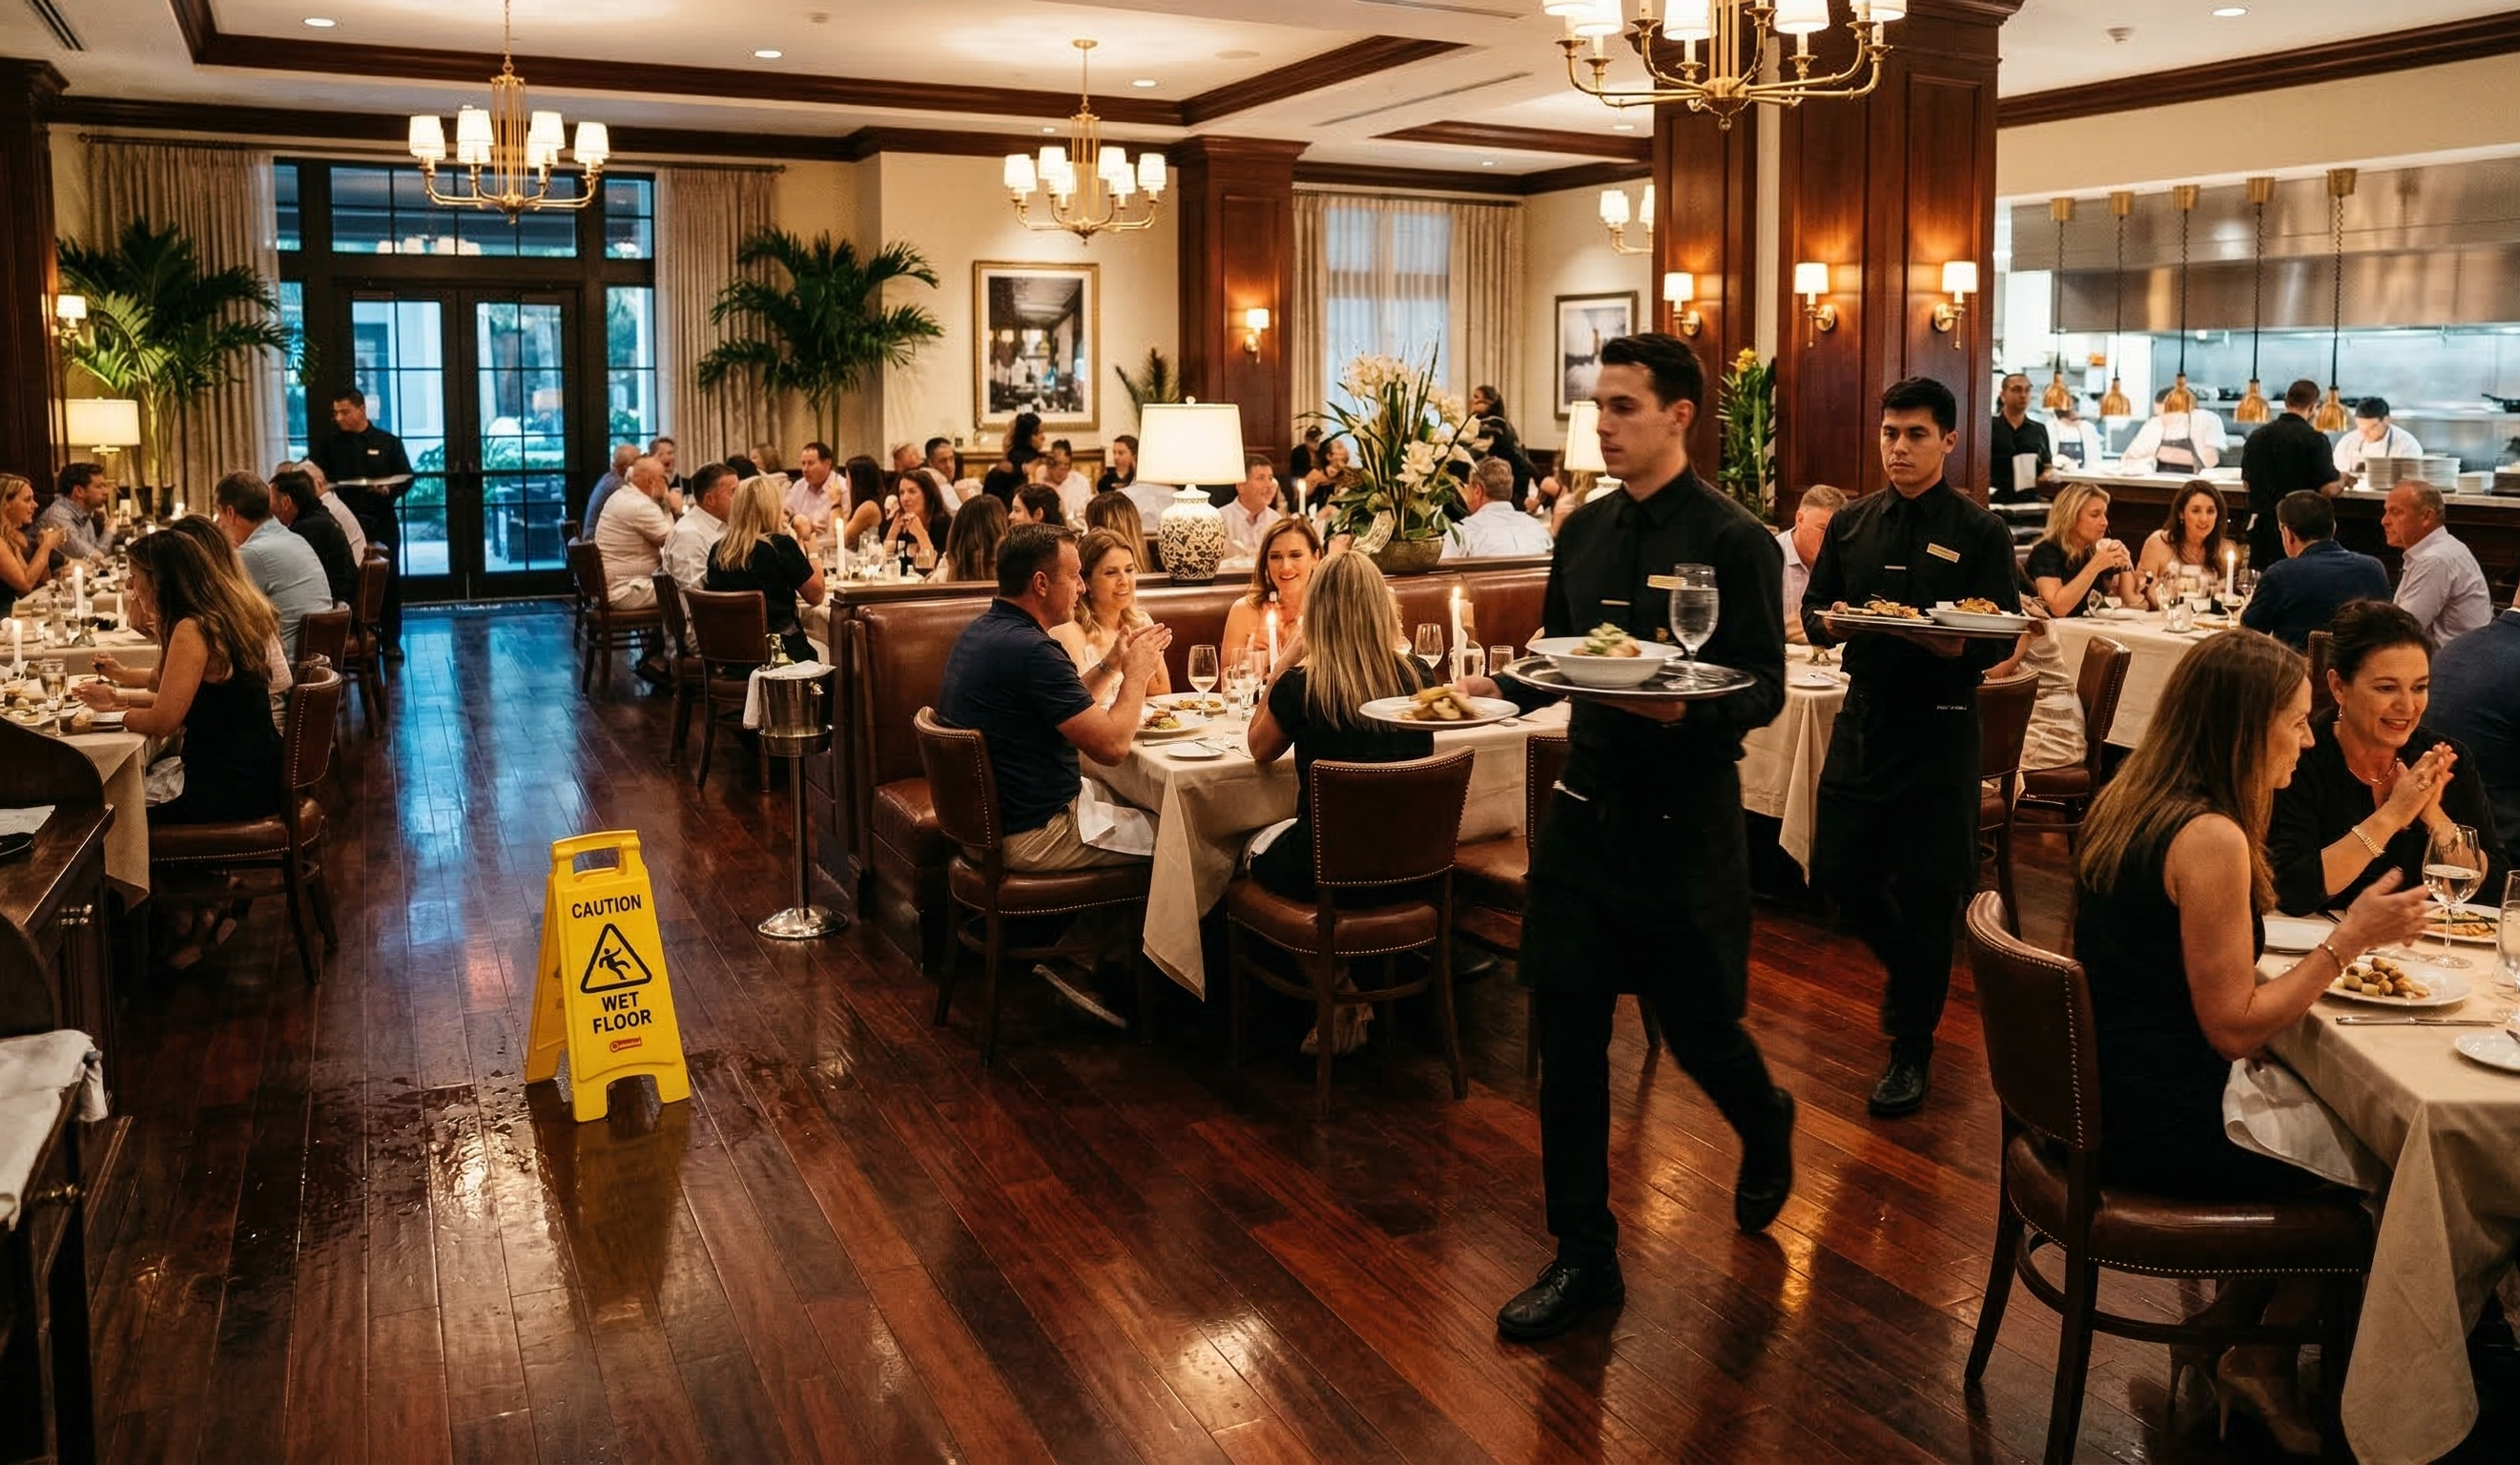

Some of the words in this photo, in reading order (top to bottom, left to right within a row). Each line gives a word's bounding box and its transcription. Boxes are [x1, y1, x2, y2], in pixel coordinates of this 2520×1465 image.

[571, 894, 642, 918] CAUTION
[602, 991, 639, 1012] WET
[592, 1009, 652, 1034] FLOOR
